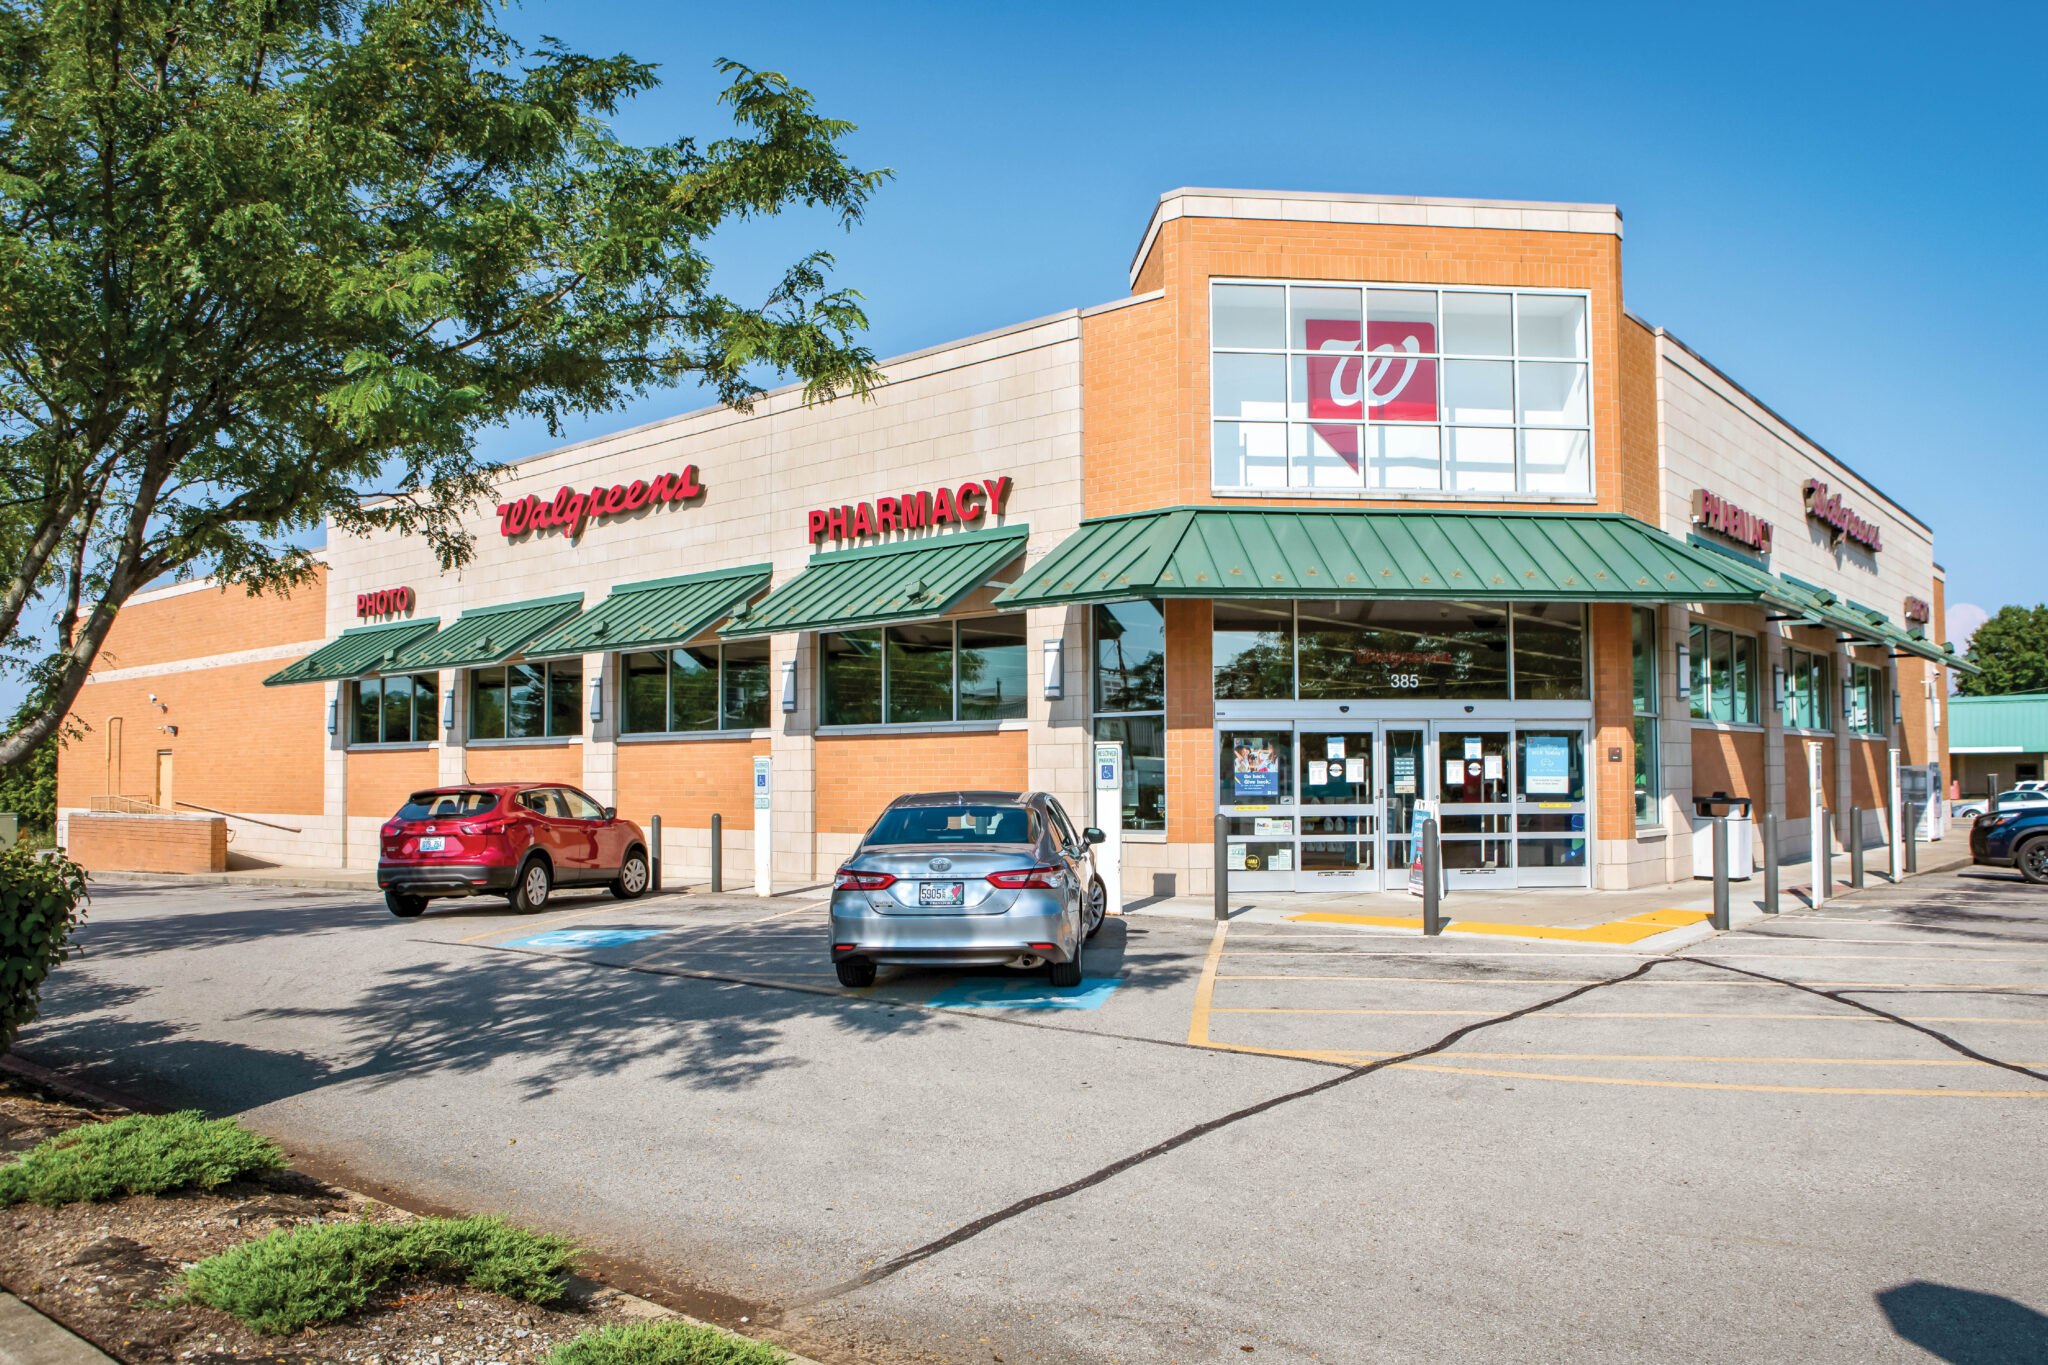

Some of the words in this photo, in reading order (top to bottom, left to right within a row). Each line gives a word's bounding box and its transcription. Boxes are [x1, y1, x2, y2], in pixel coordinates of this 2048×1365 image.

[496, 464, 700, 538] Walgreens
[808, 476, 1006, 544] PHARMACY
[356, 586, 408, 617] PHOTO
[1390, 673, 1419, 689] 385
[921, 888, 942, 899] 5905
